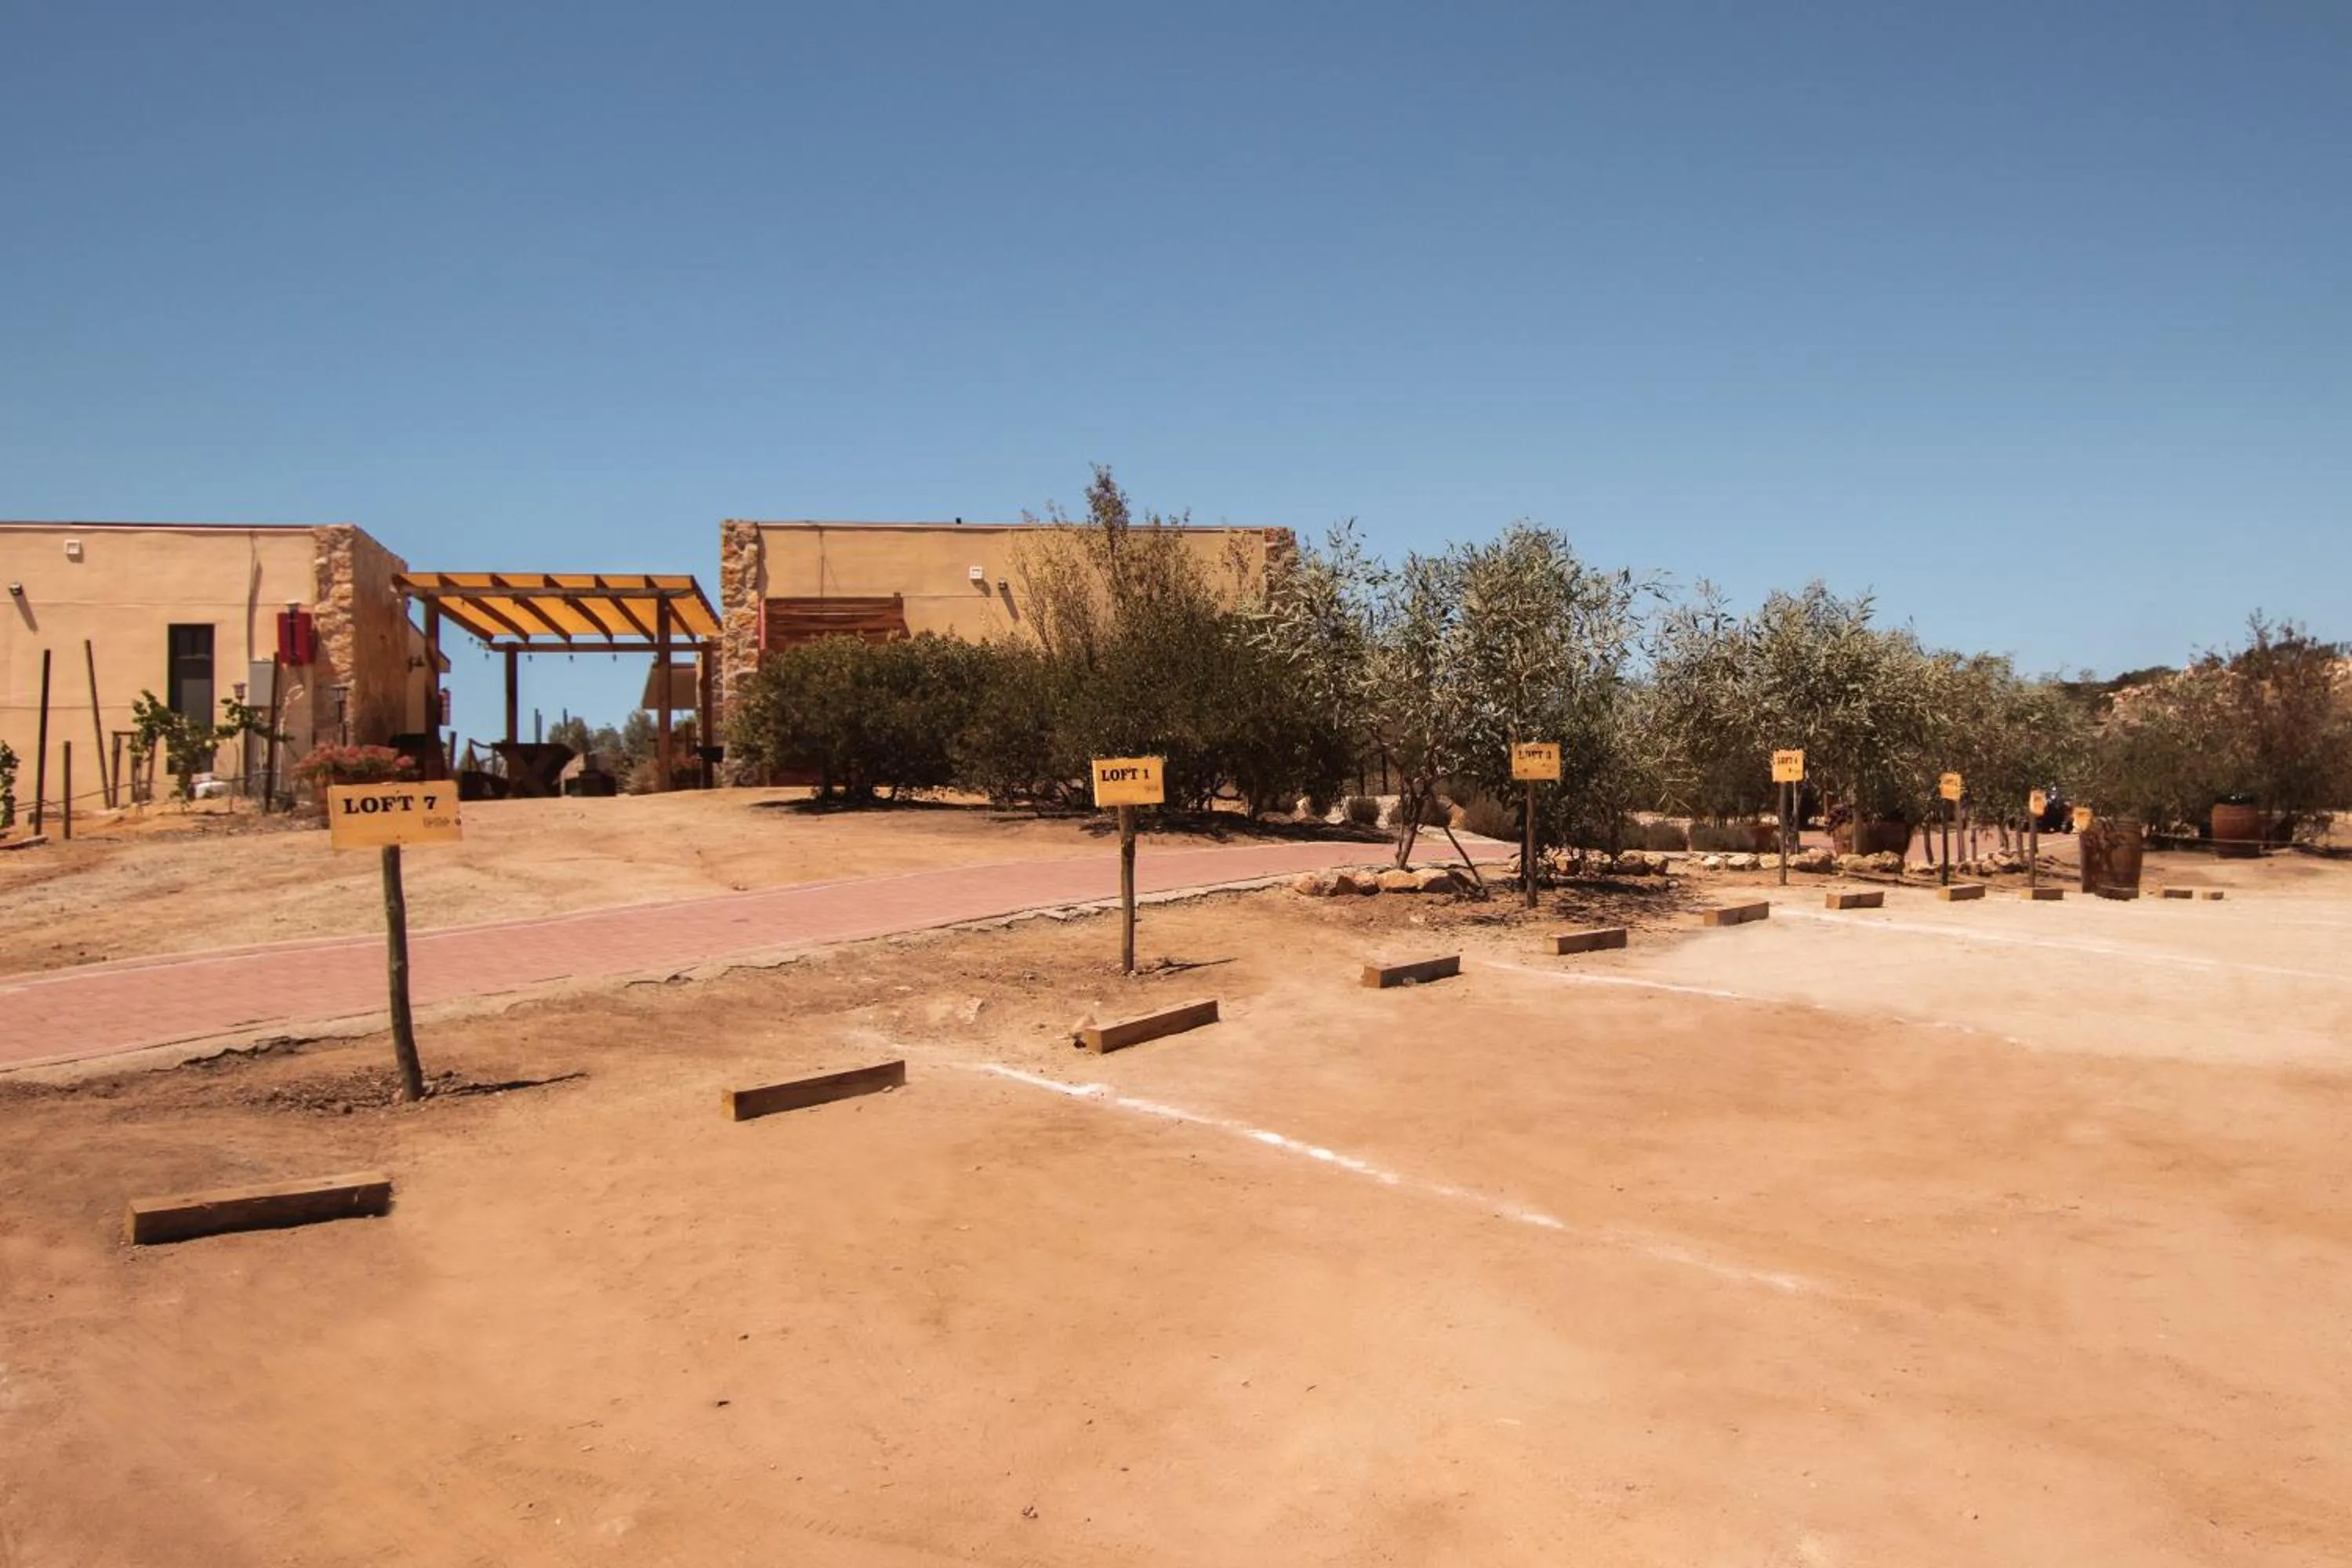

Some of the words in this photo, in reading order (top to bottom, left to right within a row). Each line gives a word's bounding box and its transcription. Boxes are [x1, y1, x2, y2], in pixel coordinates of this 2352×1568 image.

[1101, 768, 1138, 782] LOFT
[1143, 768, 1149, 779] 1
[343, 795, 414, 814] LOFT
[424, 796, 437, 810] 7
